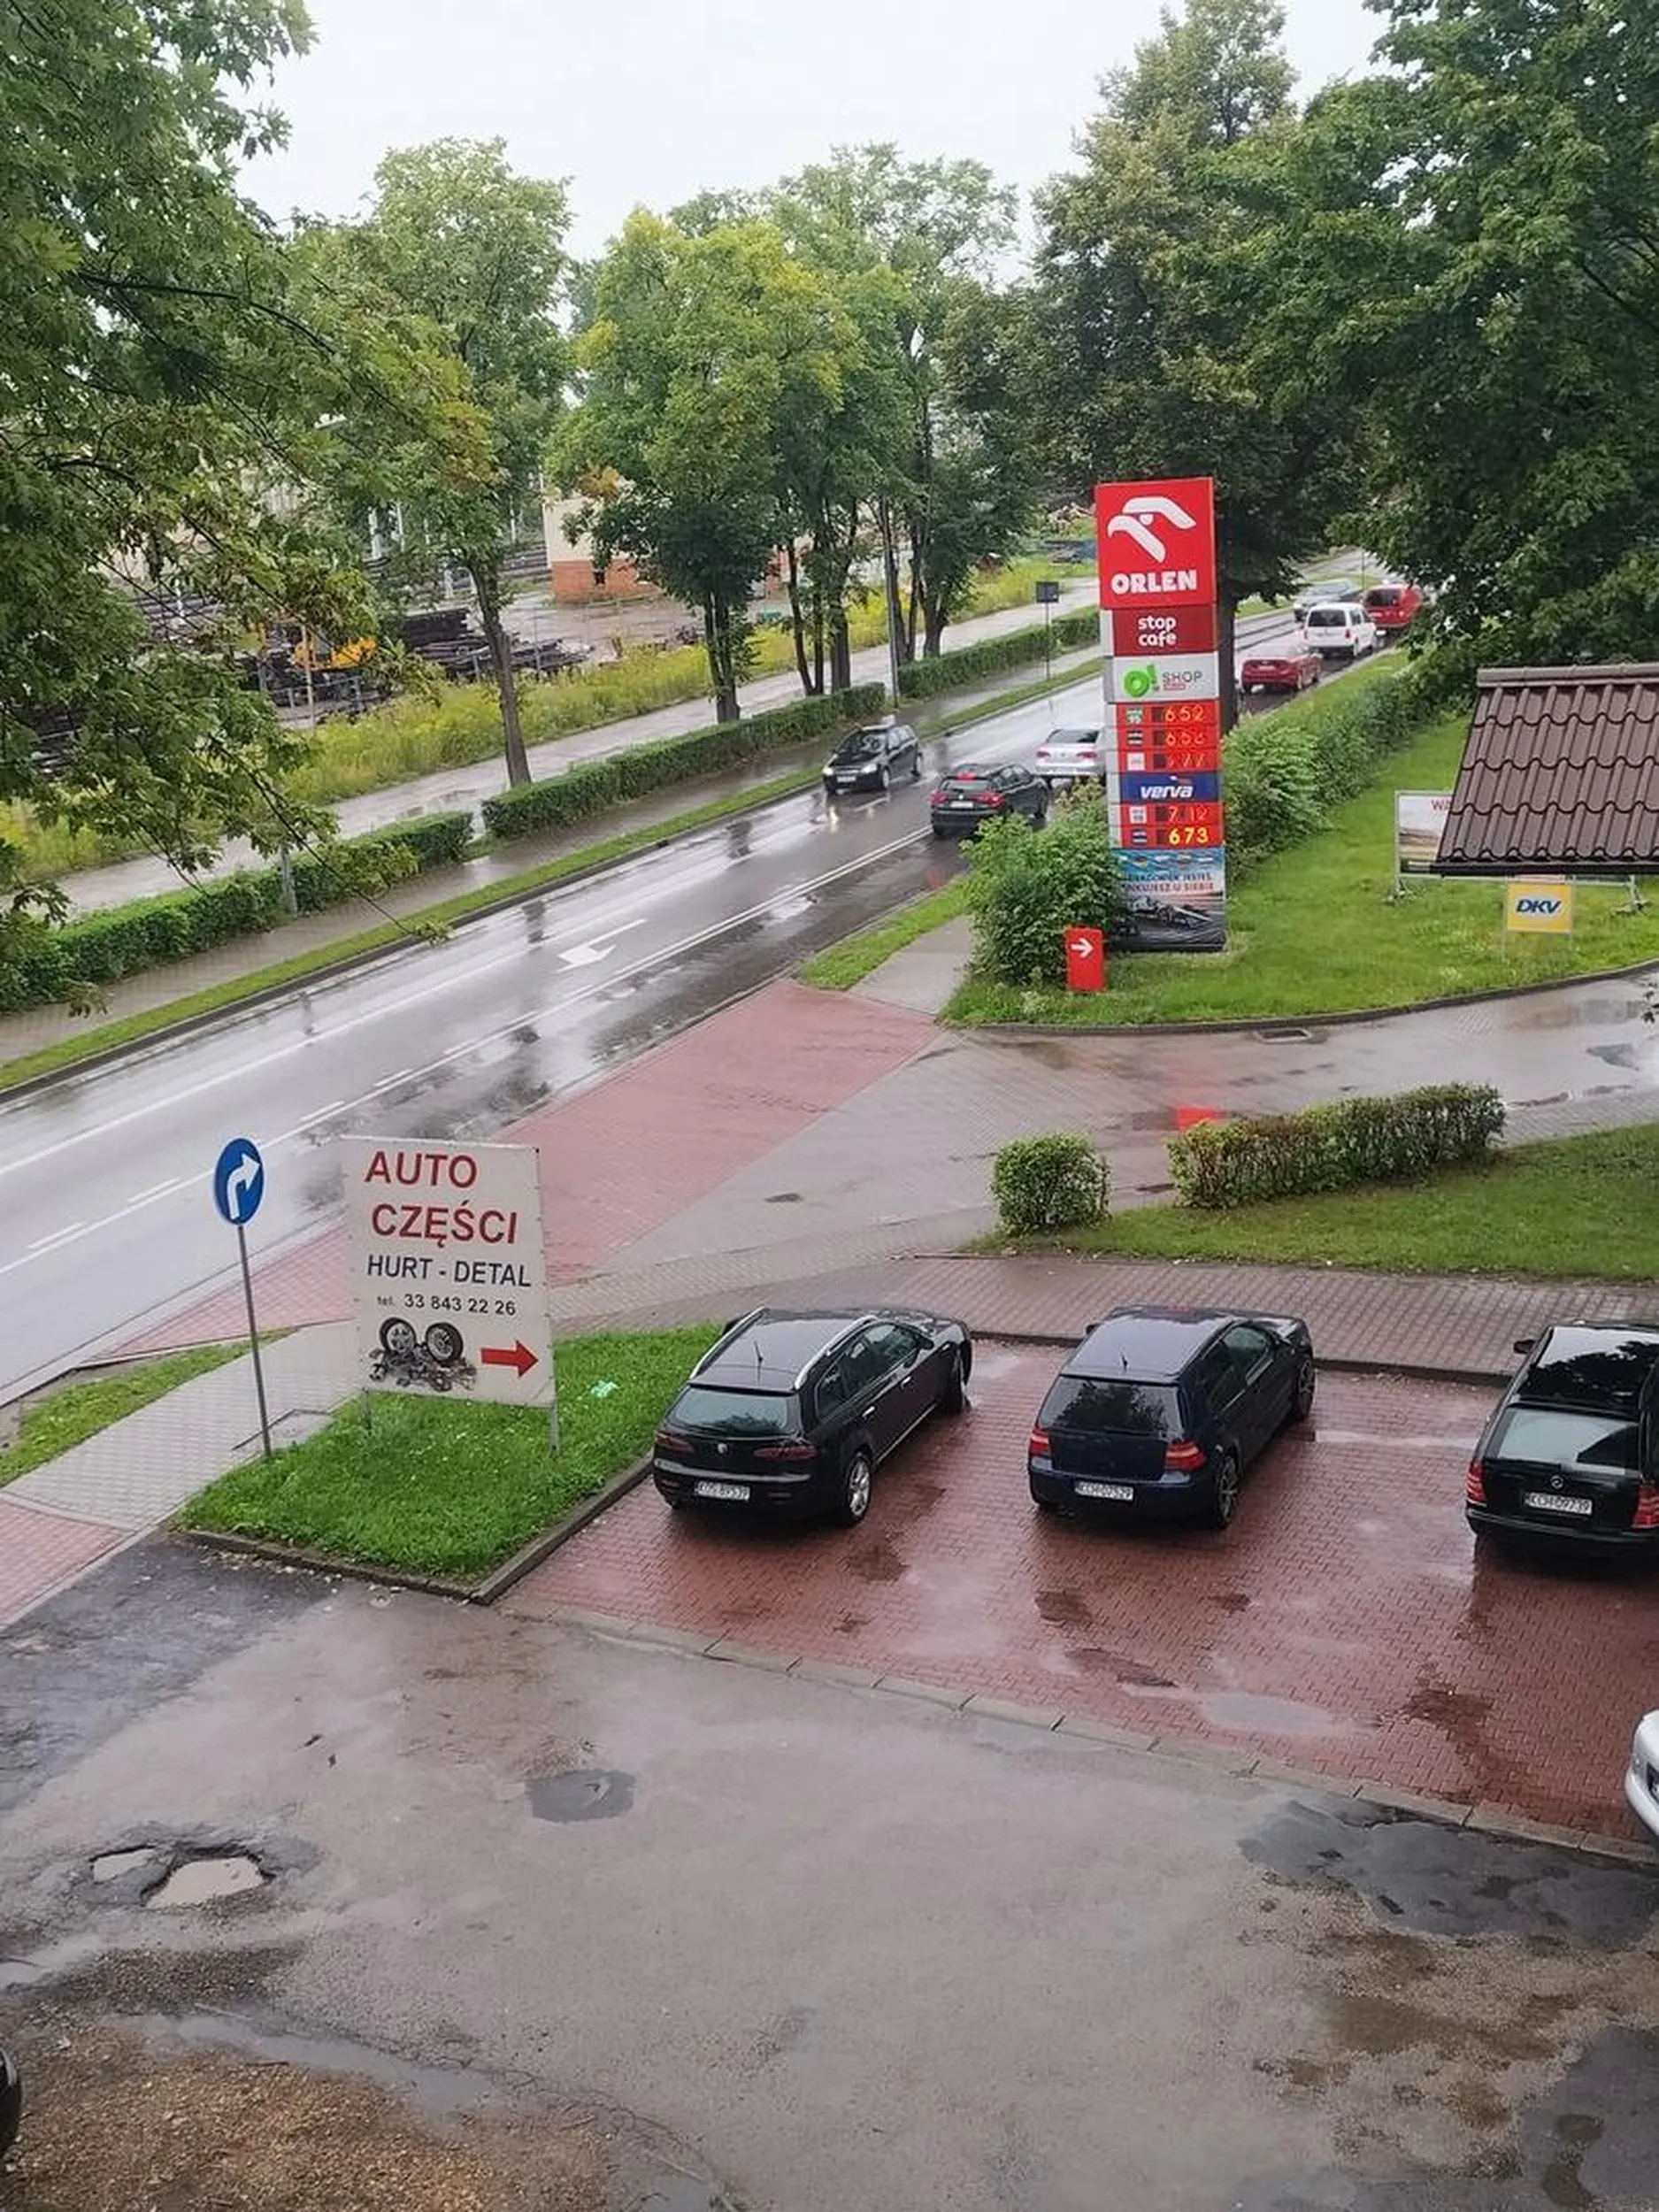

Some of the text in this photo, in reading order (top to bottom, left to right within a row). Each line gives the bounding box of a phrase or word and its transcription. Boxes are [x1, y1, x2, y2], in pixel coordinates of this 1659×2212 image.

[1110, 570, 1197, 595] ORLEN
[1138, 615, 1176, 632] stop
[1138, 631, 1177, 648] cafe
[1163, 671, 1202, 683] SHOP
[1141, 786, 1194, 799] verva
[1169, 827, 1209, 846] 673
[1516, 899, 1562, 914] DKV
[364, 1150, 478, 1188] AUTO
[371, 1200, 518, 1248] CZĘŚCI
[367, 1255, 433, 1279] HURT
[454, 1261, 531, 1286] DETAL
[404, 1294, 426, 1309] 33
[430, 1295, 463, 1311] 843
[468, 1298, 488, 1314] 22
[495, 1300, 517, 1316] 26
